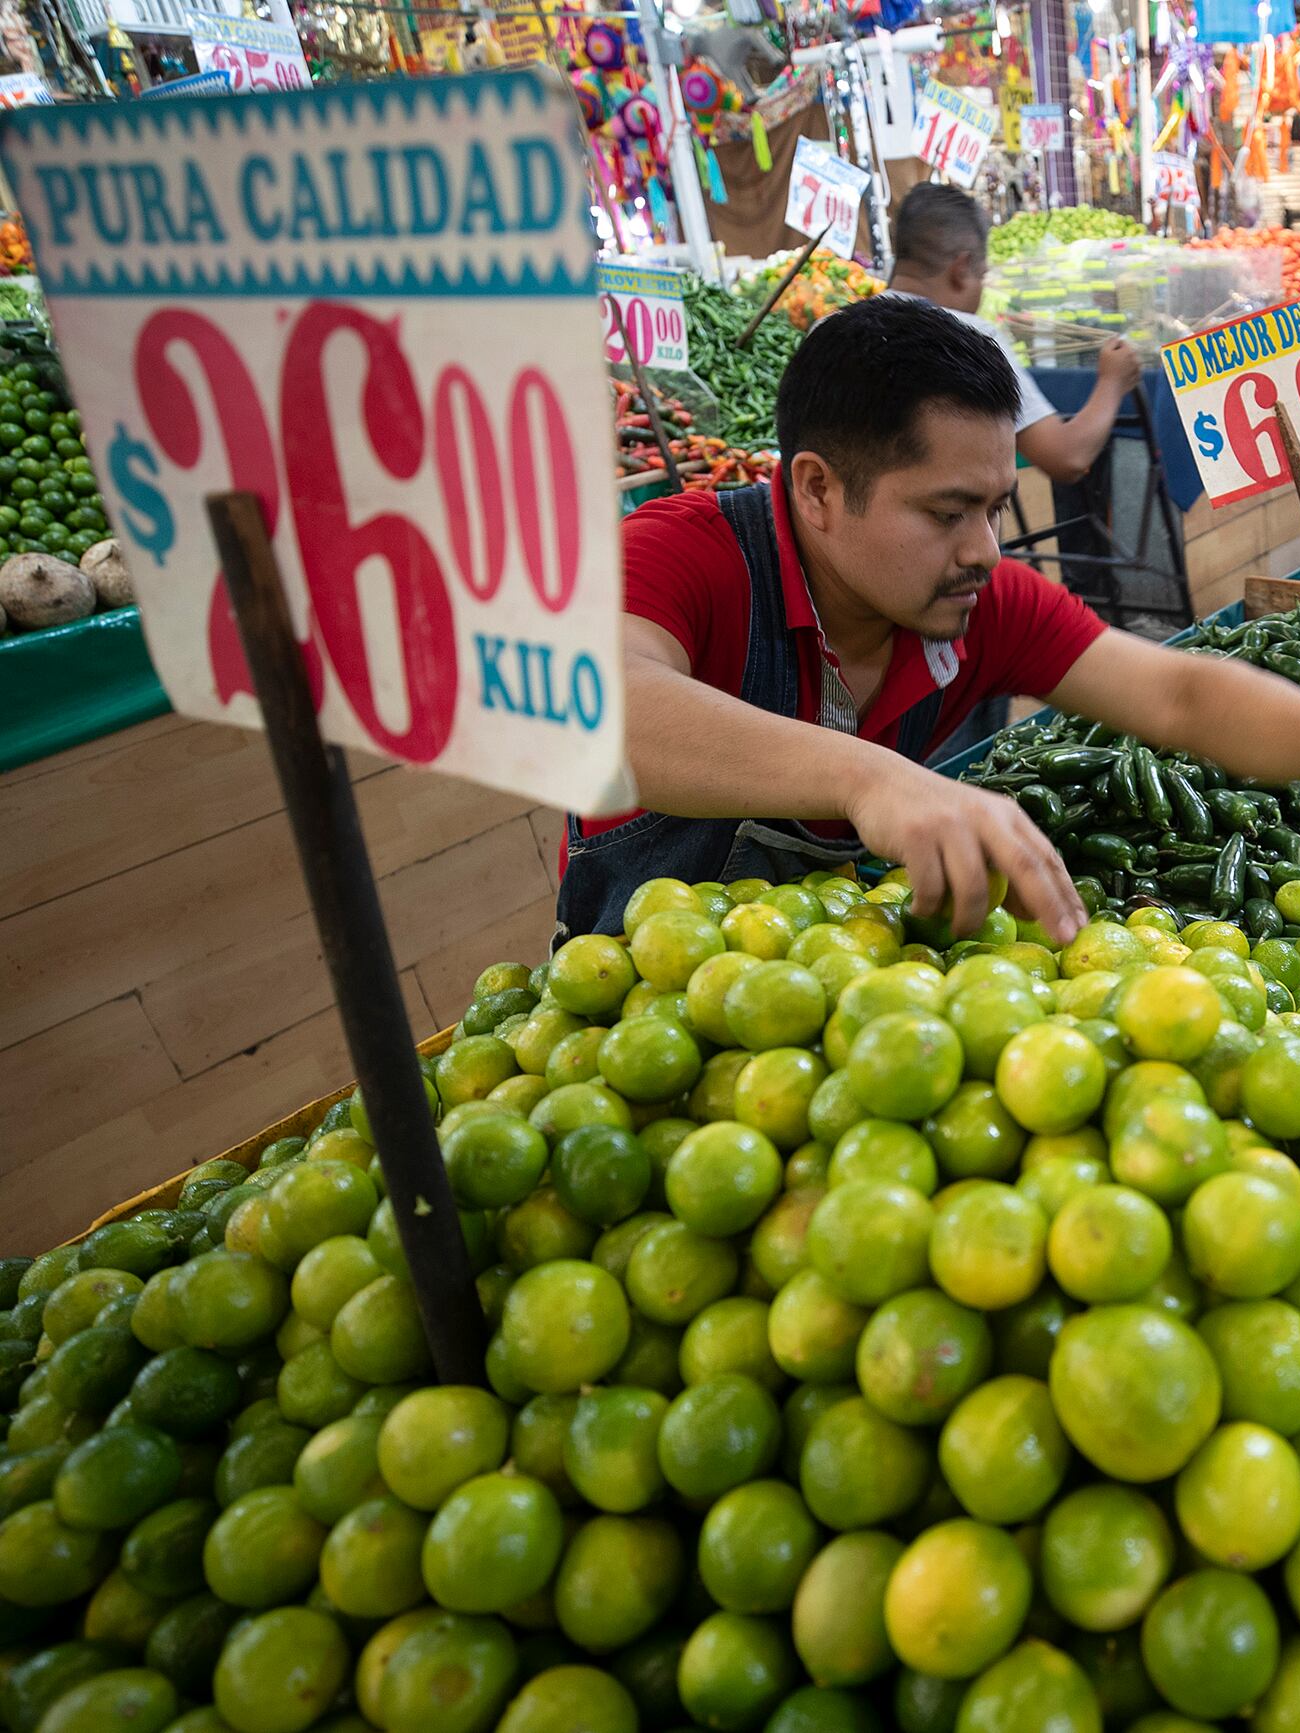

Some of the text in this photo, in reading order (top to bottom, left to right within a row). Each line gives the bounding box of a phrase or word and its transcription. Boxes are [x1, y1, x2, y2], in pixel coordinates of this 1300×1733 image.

[36, 137, 566, 247] PURA CALIDAD
[656, 345, 684, 361] KILO
[1164, 342, 1199, 388] LO
[1196, 315, 1277, 378] MEJOR
[473, 632, 603, 732] KILO
